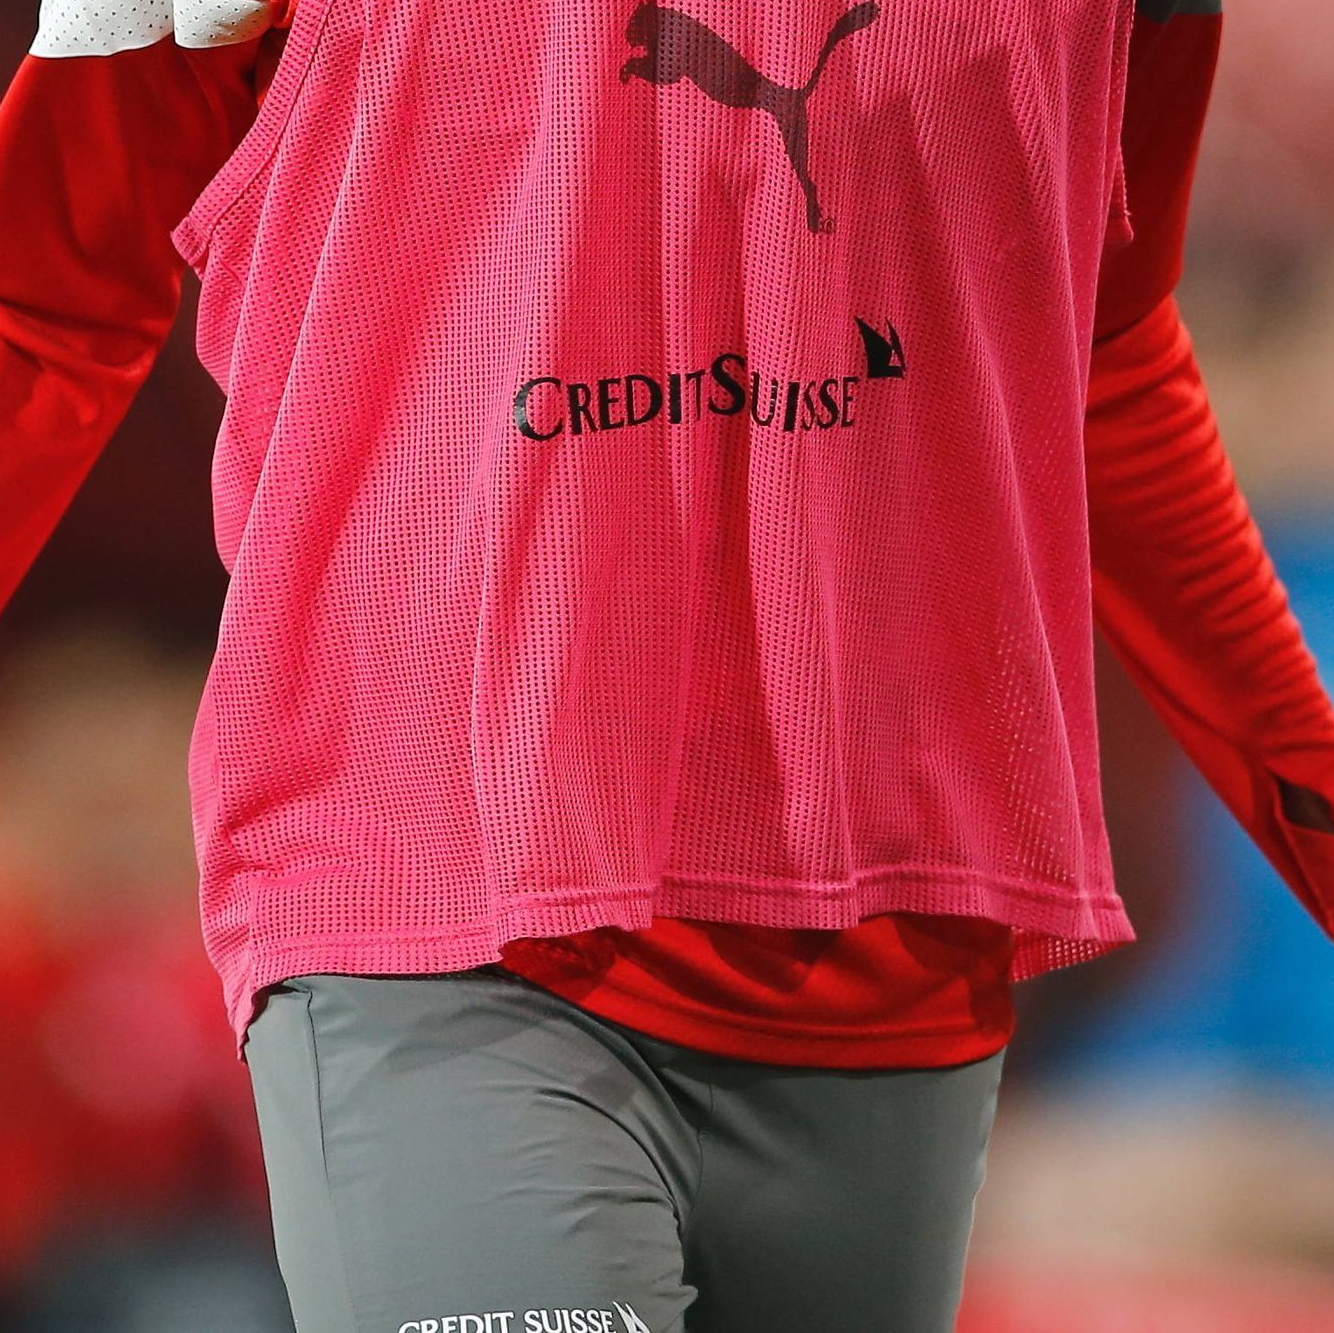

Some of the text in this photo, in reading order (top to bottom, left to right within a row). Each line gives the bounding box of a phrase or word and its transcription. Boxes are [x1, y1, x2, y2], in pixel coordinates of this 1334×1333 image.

[513, 353, 860, 441] CREDIT SUISSE
[524, 1308, 617, 1333] SUISSE
